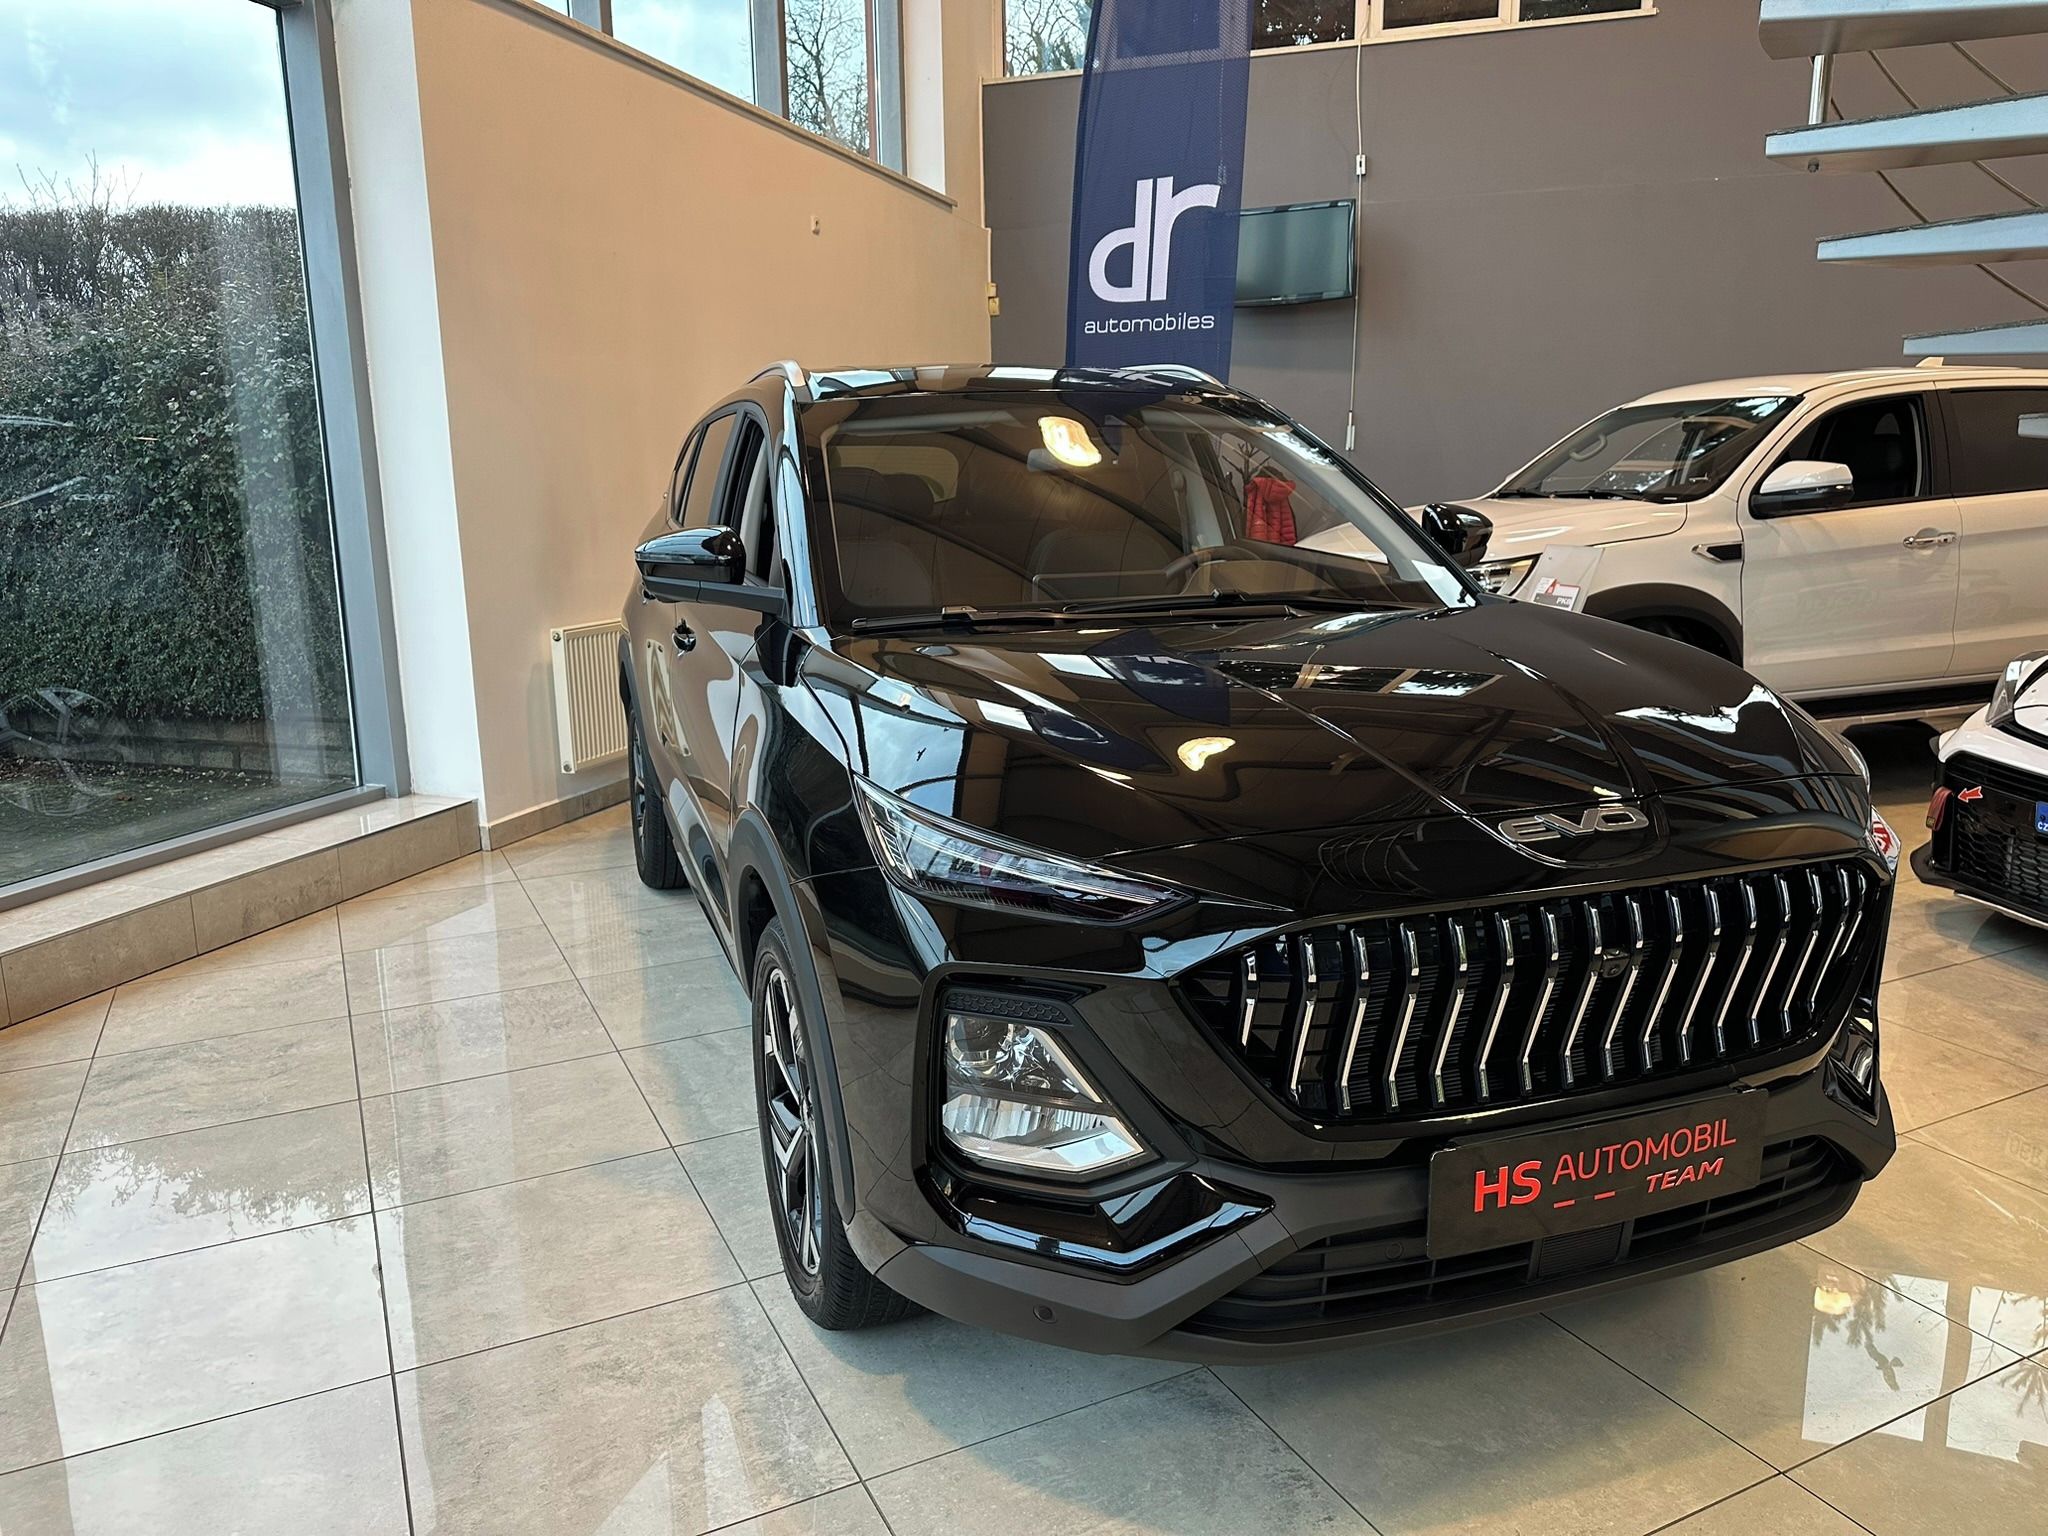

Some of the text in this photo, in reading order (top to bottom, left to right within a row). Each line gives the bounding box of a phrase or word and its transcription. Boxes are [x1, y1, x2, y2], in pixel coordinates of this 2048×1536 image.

[1088, 176, 1221, 302] dr
[1084, 312, 1215, 334] automobiles
[1498, 807, 1650, 843] EVO
[1473, 1118, 1737, 1213] HS AUTOMOBIL
[1646, 1157, 1724, 1193] TEAM
